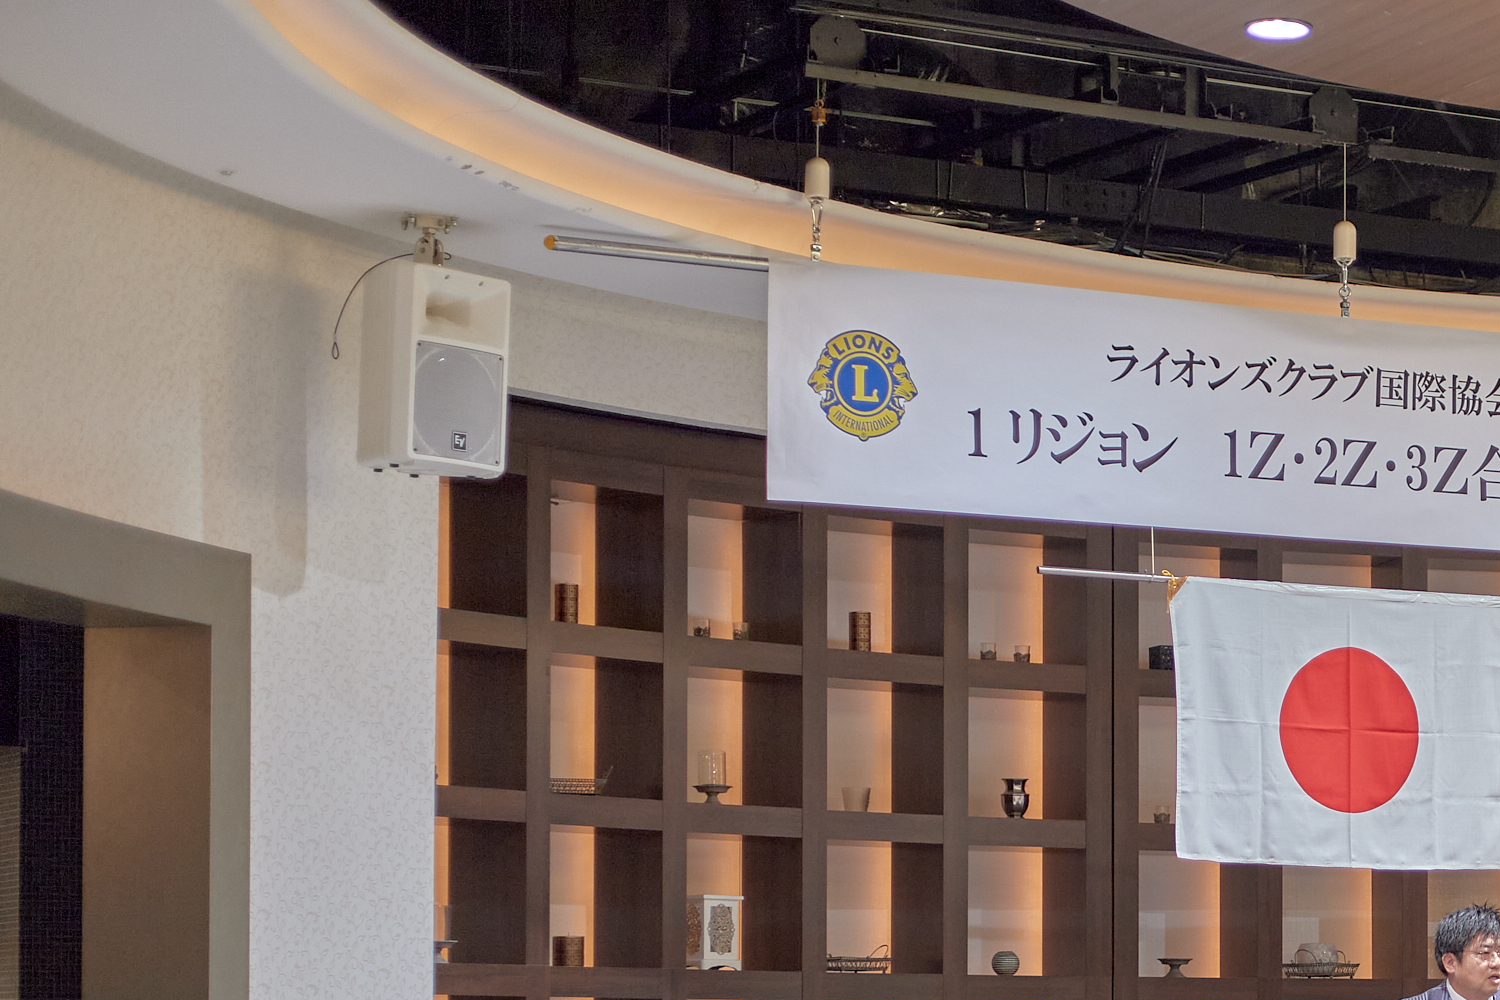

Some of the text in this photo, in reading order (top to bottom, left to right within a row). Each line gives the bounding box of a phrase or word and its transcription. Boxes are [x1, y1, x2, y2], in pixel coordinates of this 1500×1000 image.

[832, 334, 895, 361] LIONS
[851, 364, 879, 403] L
[832, 409, 895, 432] INTERNATIONAL
